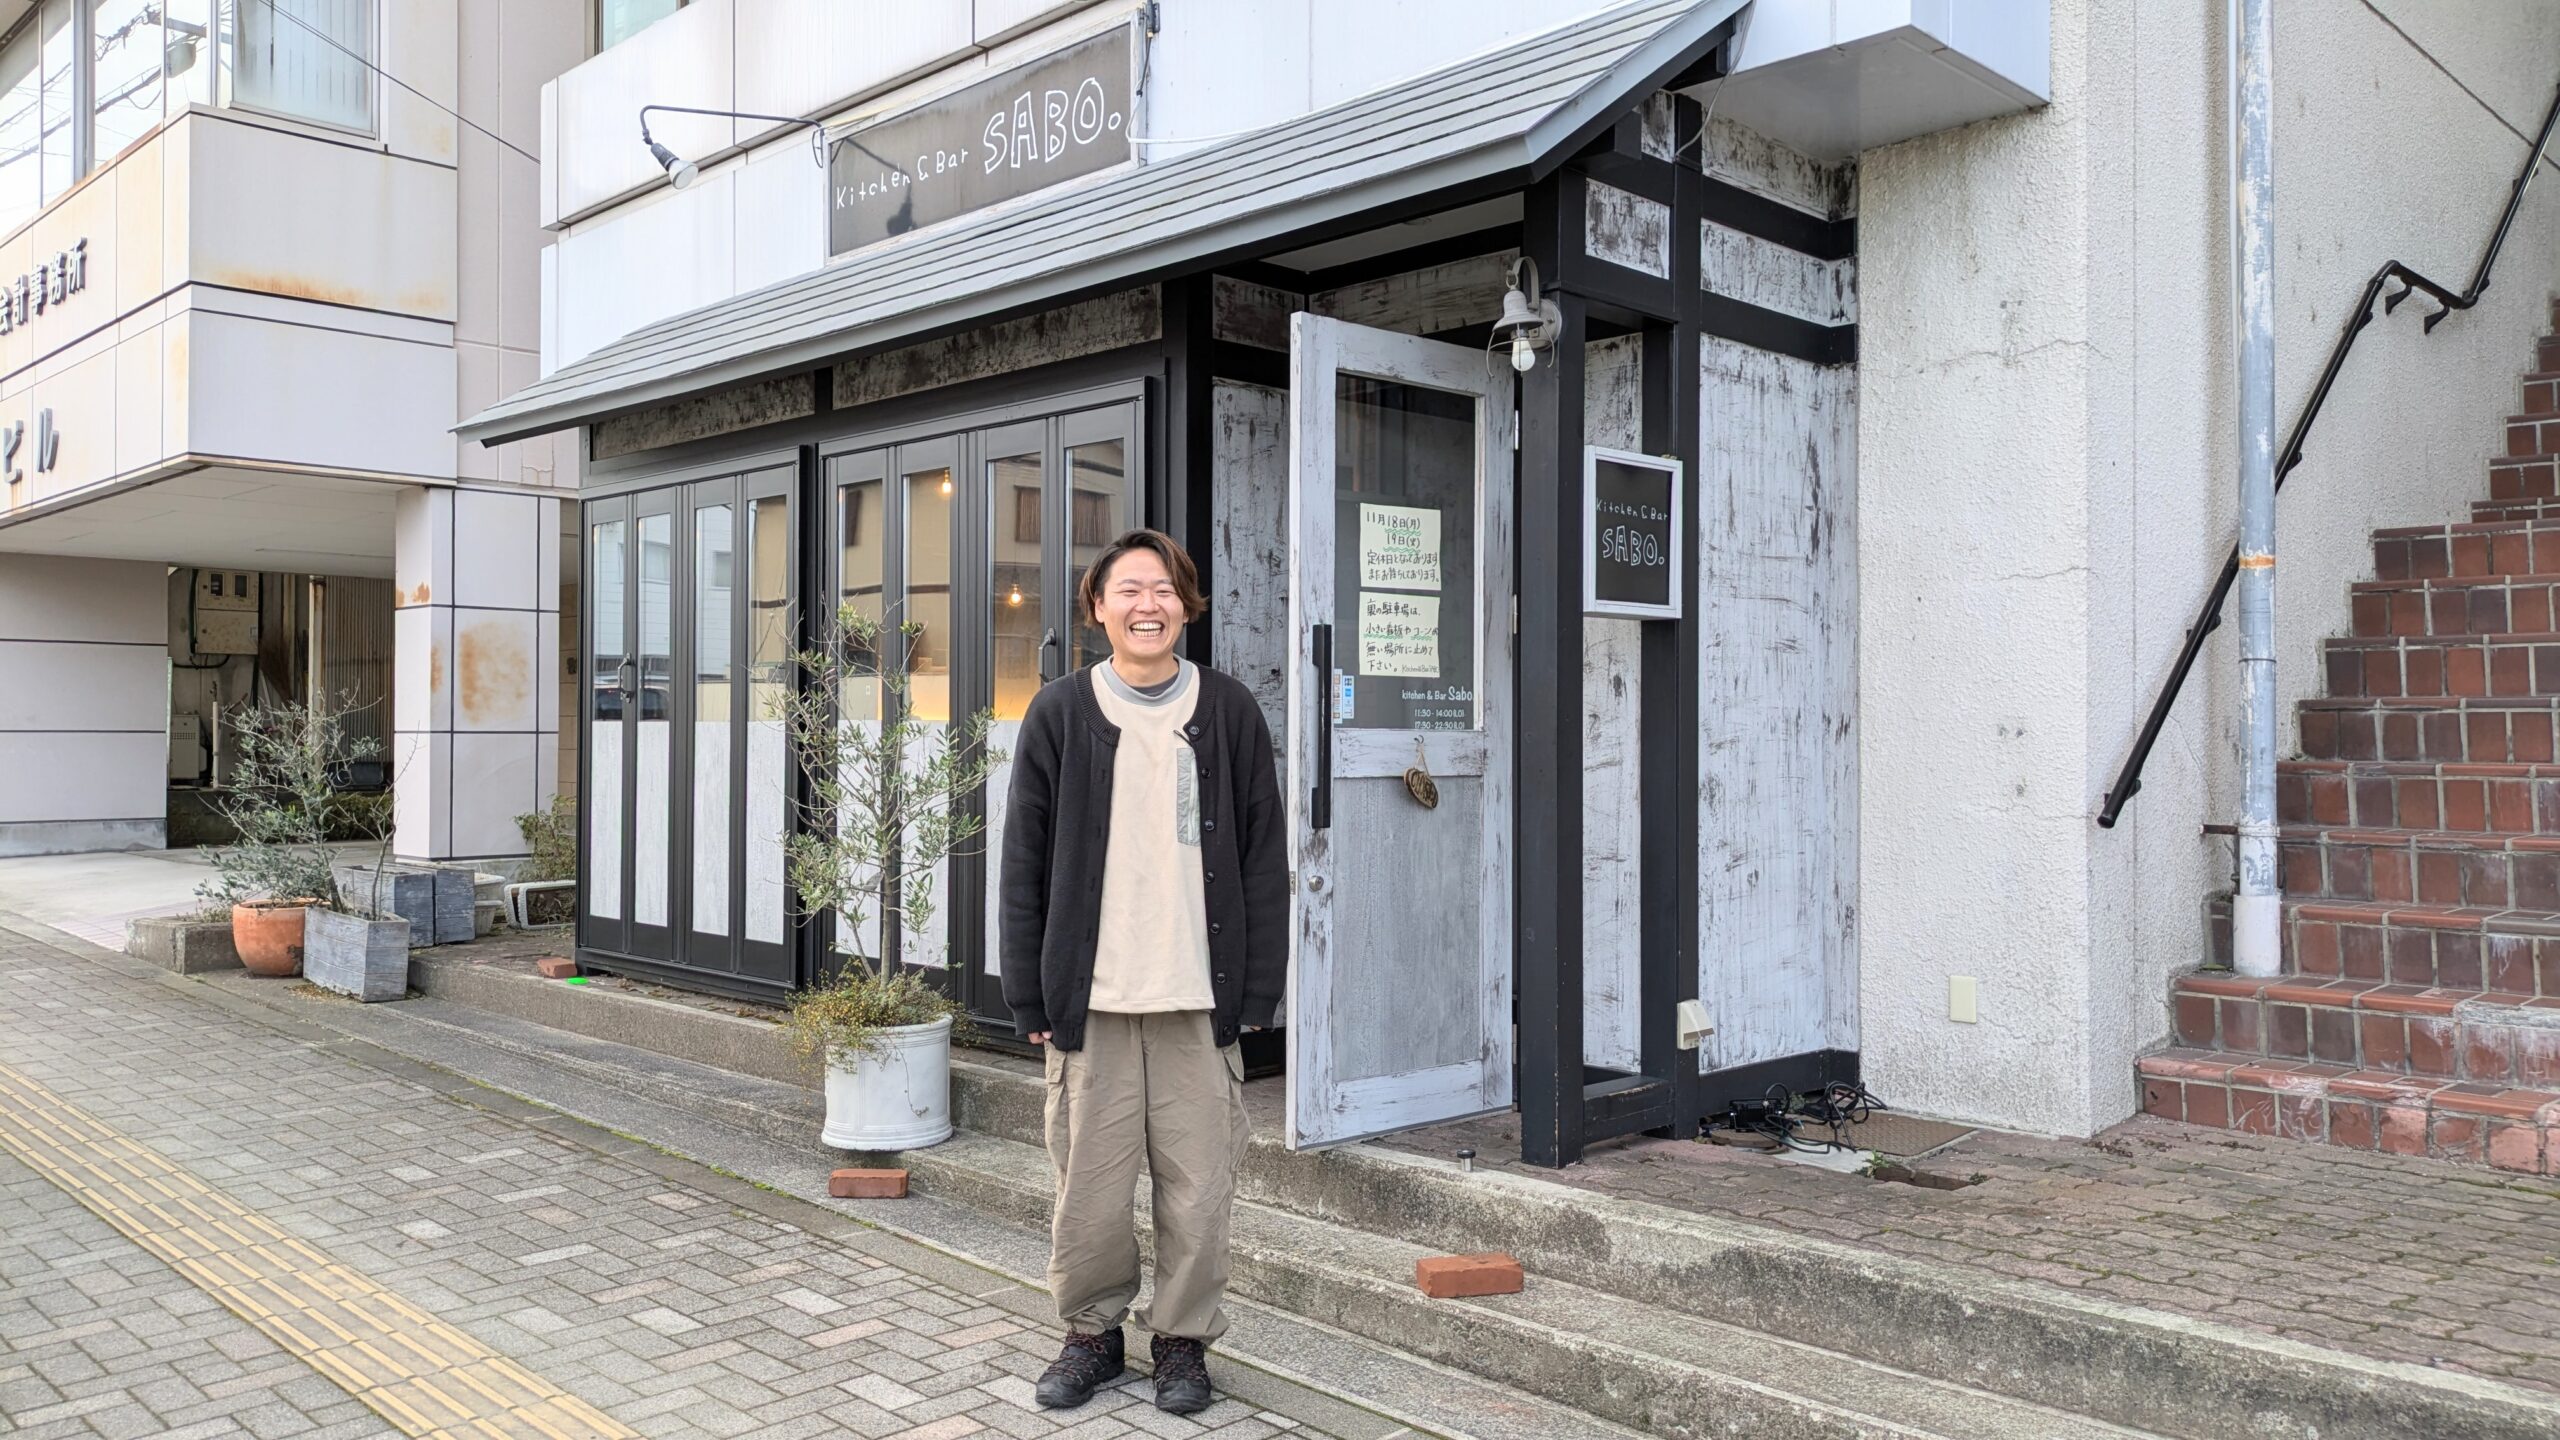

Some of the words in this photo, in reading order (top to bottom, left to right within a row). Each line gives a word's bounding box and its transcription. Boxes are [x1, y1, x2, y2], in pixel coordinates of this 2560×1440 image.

[836, 170, 911, 209] Kitchen
[936, 149, 968, 174] Bar
[4, 407, 60, 484] ビル
[1596, 498, 1638, 517] Kitchen
[1650, 507, 1668, 521] Bar
[1434, 690, 1447, 700] Bar
[1448, 686, 1473, 701] Sabo
